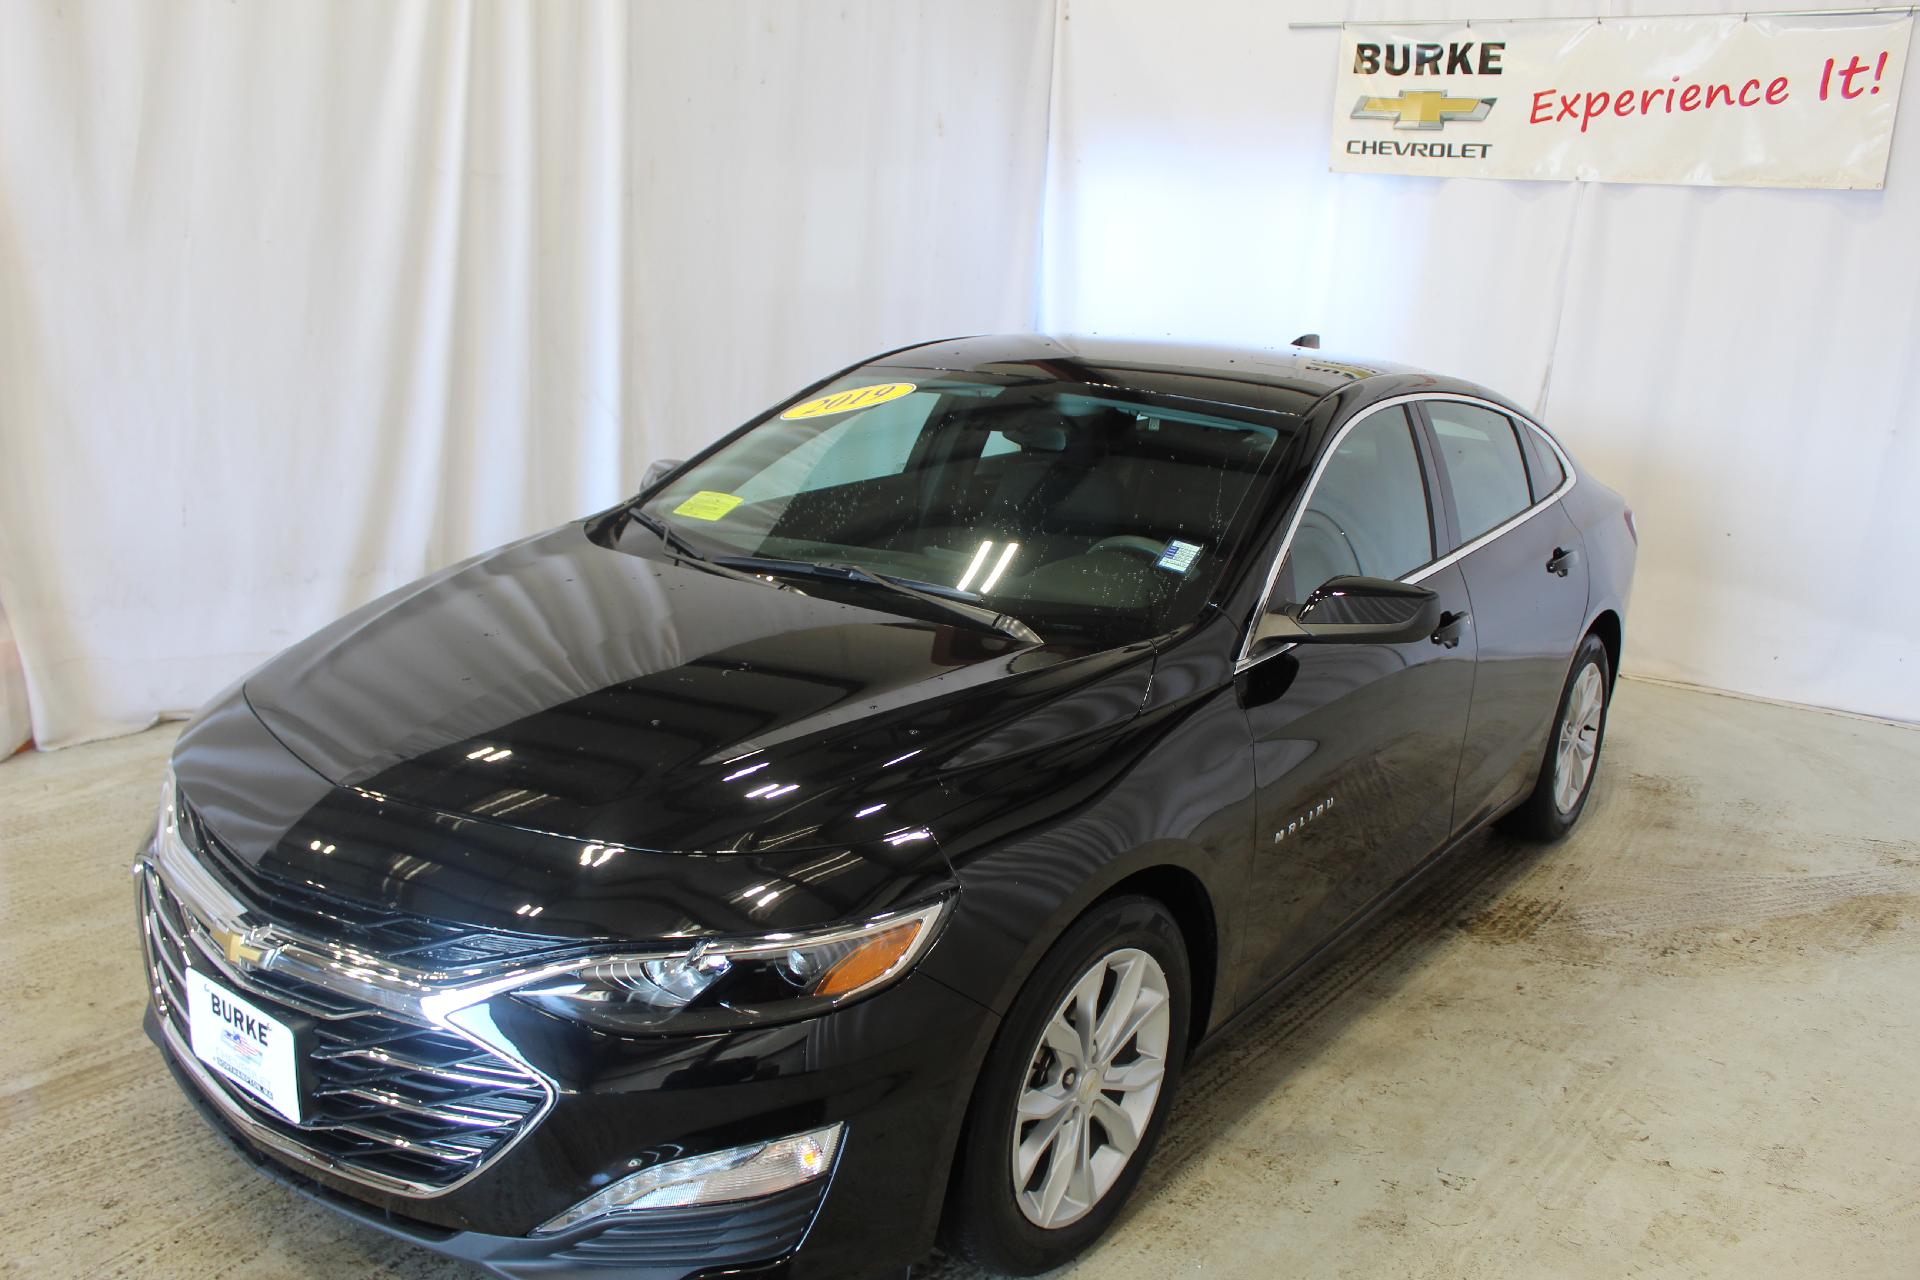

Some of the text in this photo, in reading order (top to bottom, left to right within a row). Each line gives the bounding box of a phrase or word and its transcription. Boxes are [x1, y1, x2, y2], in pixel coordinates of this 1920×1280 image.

[1353, 41, 1506, 76] BURKE
[1528, 51, 1890, 133] Experience It!
[1346, 139, 1494, 159] CHEVROLET
[801, 385, 897, 416] 2019
[1274, 796, 1335, 845] MALIBU
[211, 992, 269, 1048] BURKE
